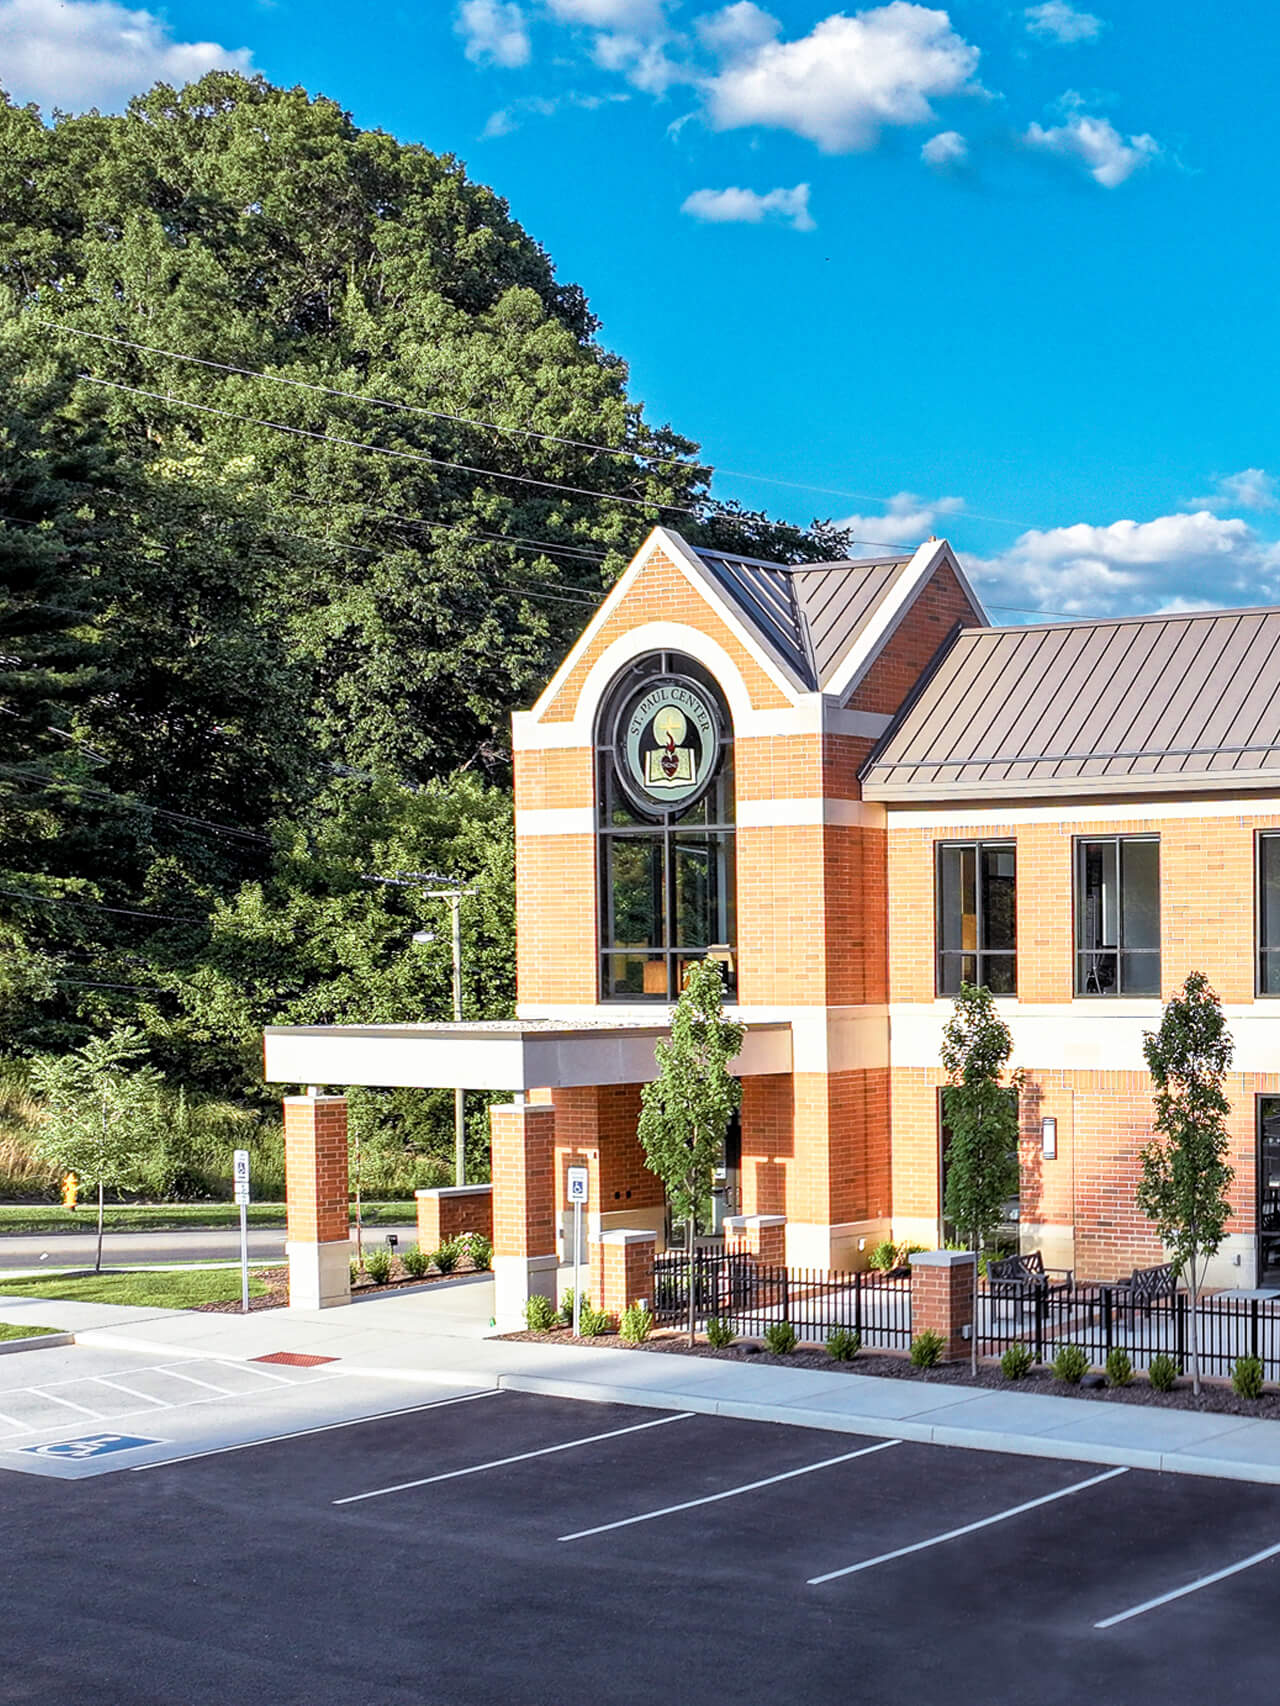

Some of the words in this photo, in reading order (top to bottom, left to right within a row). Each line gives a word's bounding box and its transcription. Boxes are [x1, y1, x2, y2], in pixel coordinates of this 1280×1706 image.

[631, 715, 643, 736] ST.
[640, 689, 669, 715] PAUL
[671, 688, 710, 733] CENTER
